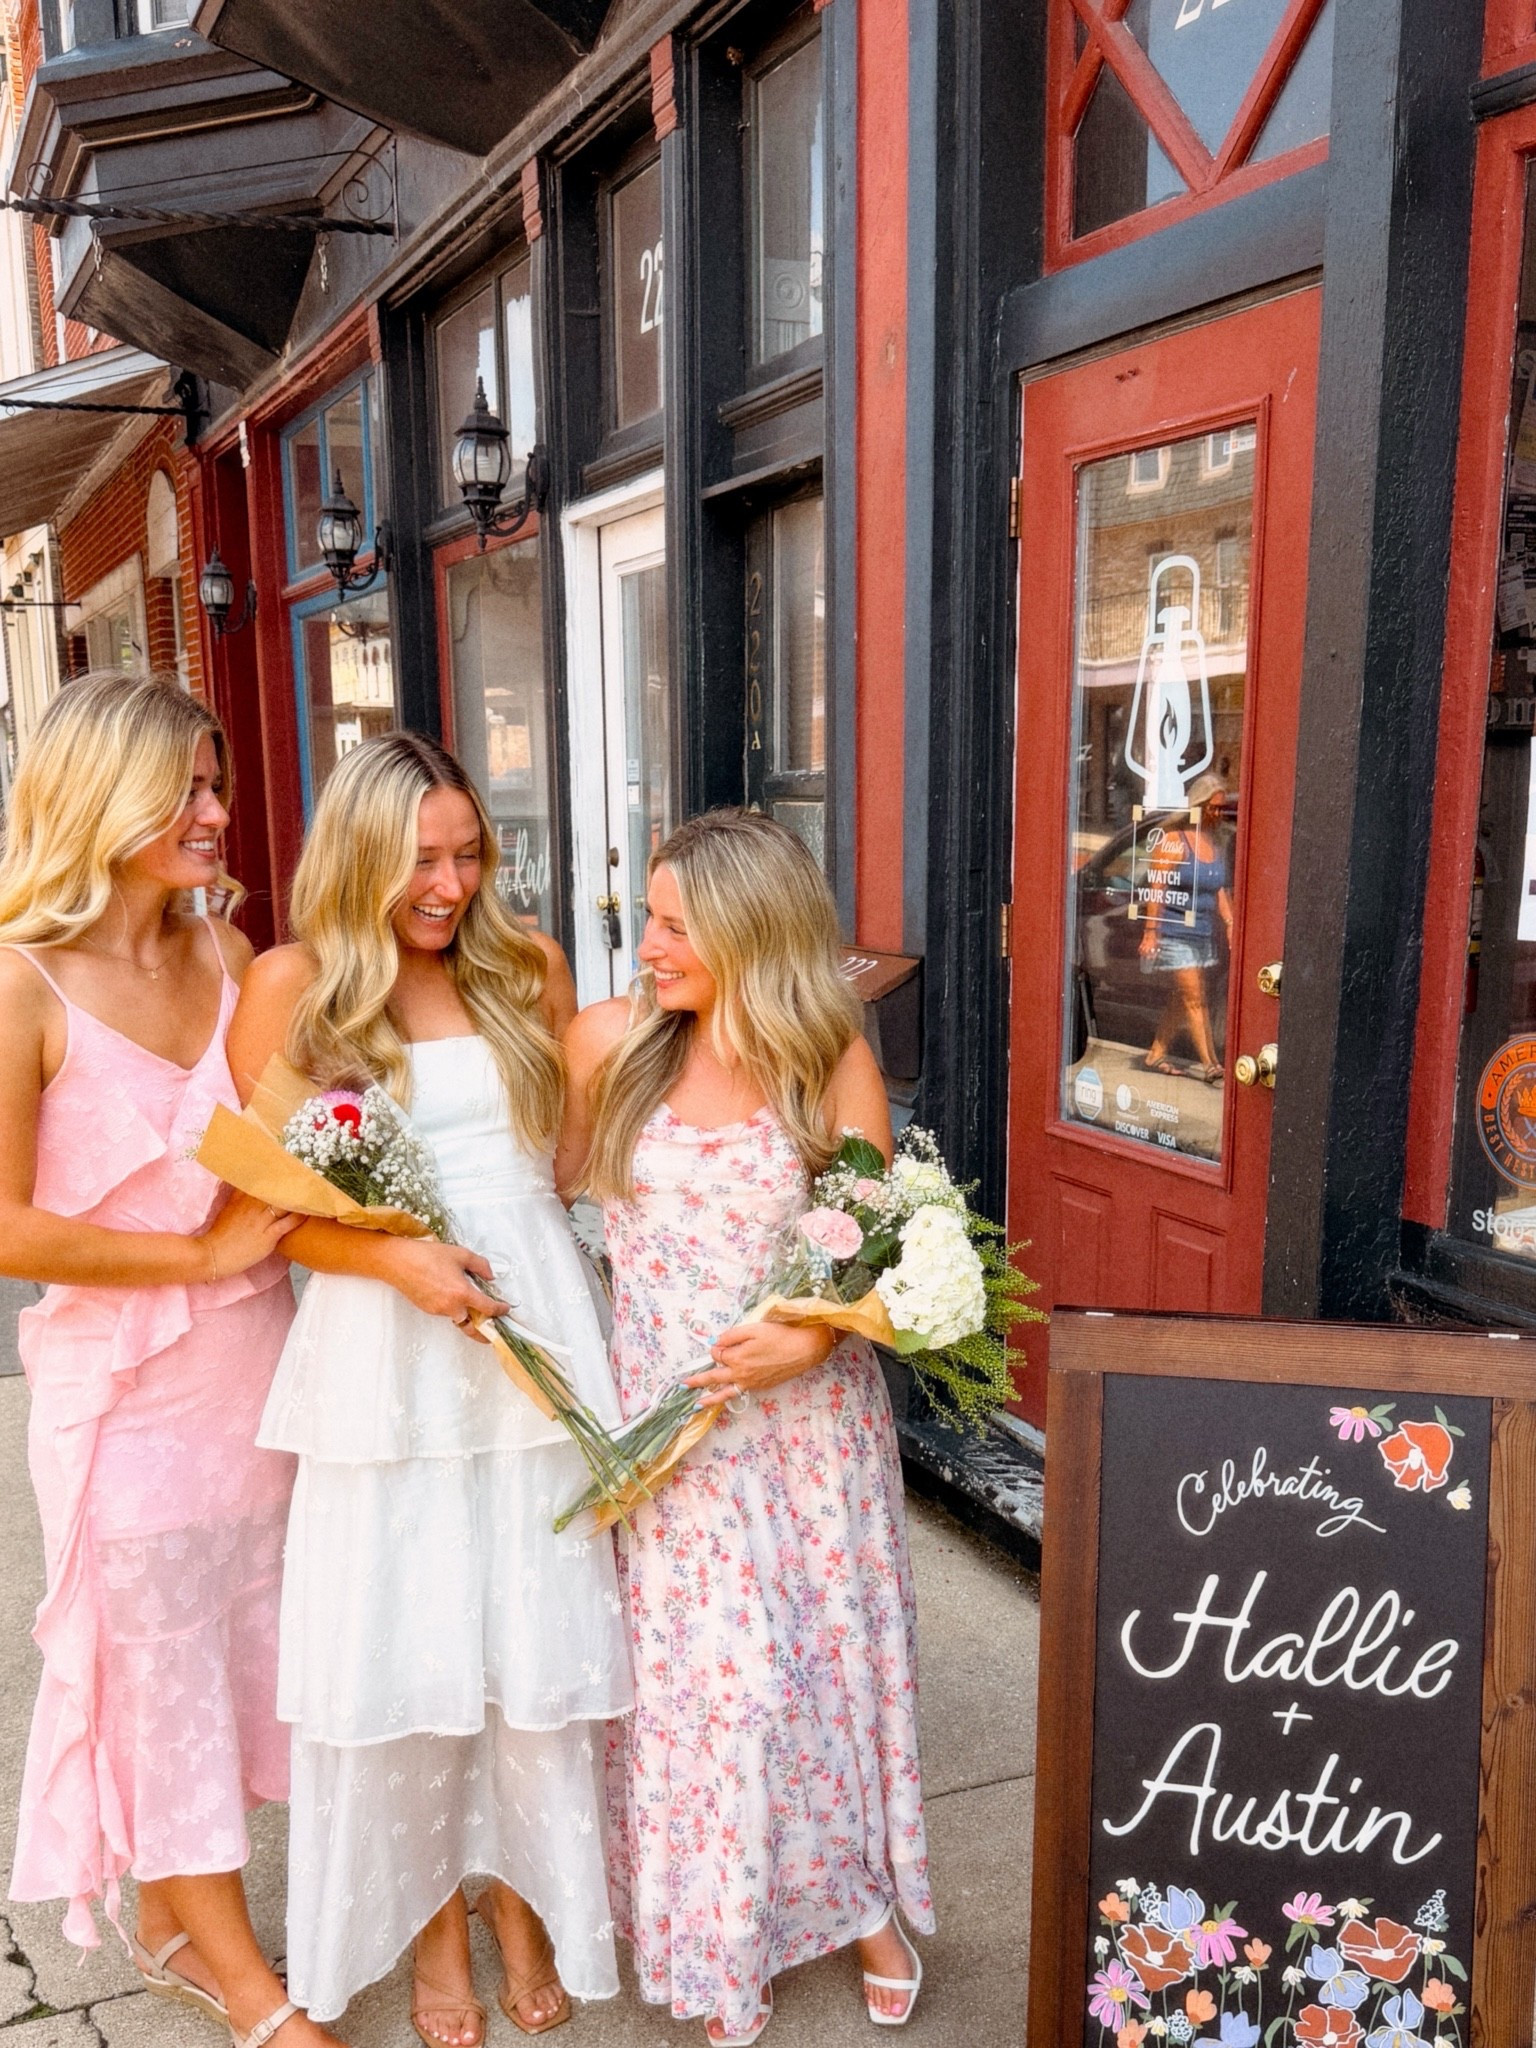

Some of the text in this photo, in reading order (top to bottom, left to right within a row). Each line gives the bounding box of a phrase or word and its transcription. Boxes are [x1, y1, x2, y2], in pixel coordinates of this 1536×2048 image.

[1146, 827, 1185, 854] Please
[1147, 869, 1181, 886] WATCH
[1138, 887, 1189, 906] YOUR STEP
[1081, 1085, 1097, 1104] ring
[1115, 1120, 1176, 1148] DISCOVER VISA
[1483, 1114, 1505, 1152] BEST
[1176, 1447, 1387, 1537] Celebrating
[1120, 1571, 1459, 1698] Hallie
[1103, 1723, 1442, 1865] Austin
